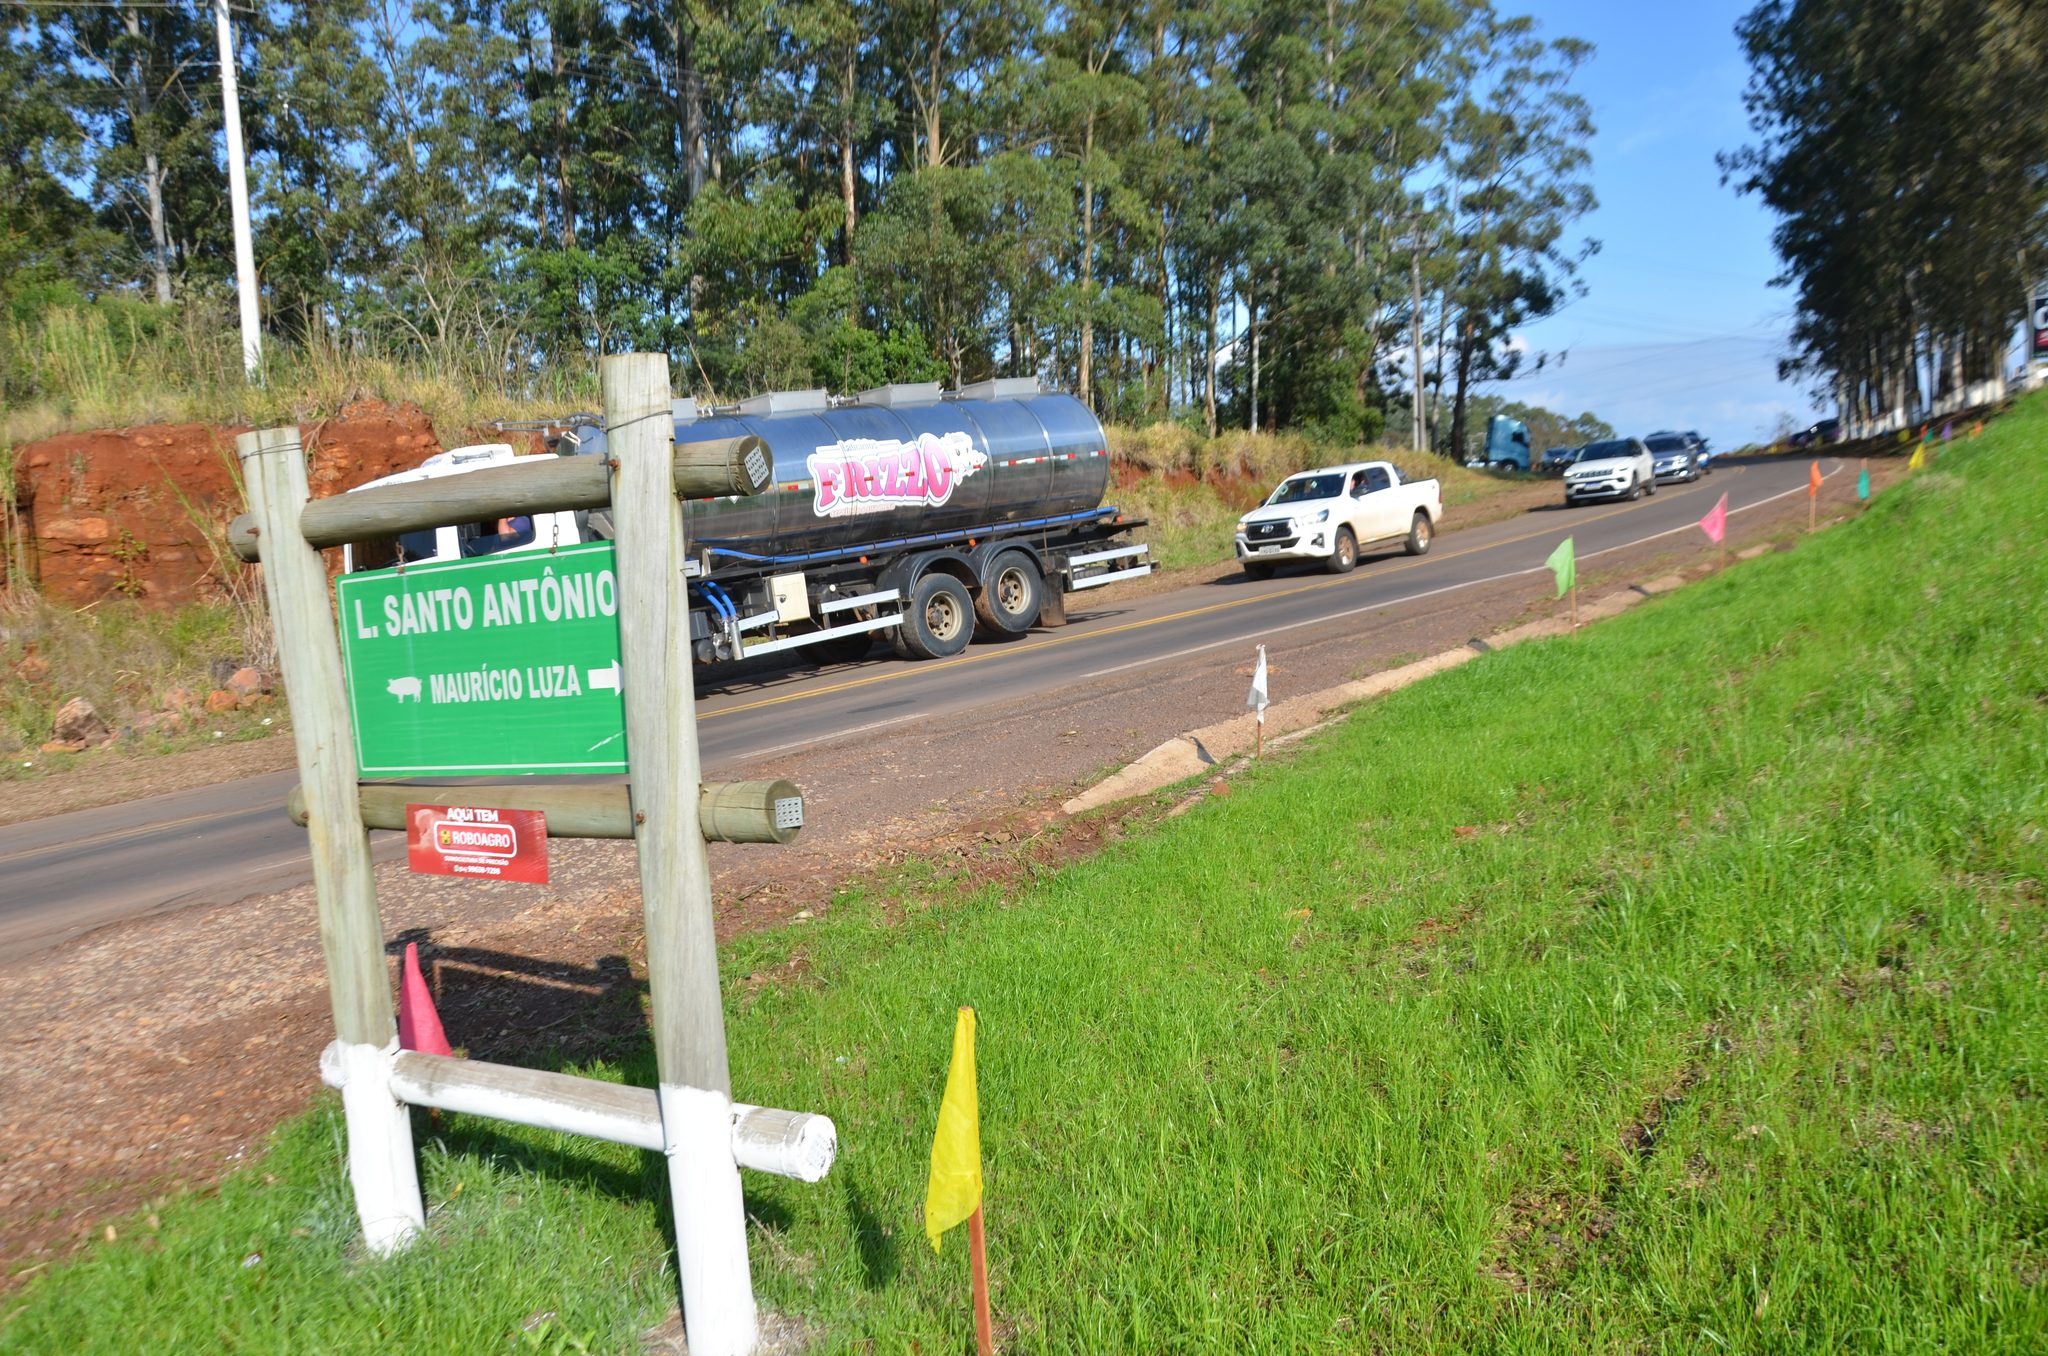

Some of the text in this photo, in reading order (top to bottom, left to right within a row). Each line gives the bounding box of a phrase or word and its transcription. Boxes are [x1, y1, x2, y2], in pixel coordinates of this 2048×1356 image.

[814, 440, 950, 507] FRIZZO
[354, 566, 618, 639] L. SANTO ANTÔNIO
[430, 663, 582, 704] MAURÍCIO LUZA
[475, 809, 499, 823] TEM
[451, 830, 511, 848] ROBOAGRO
